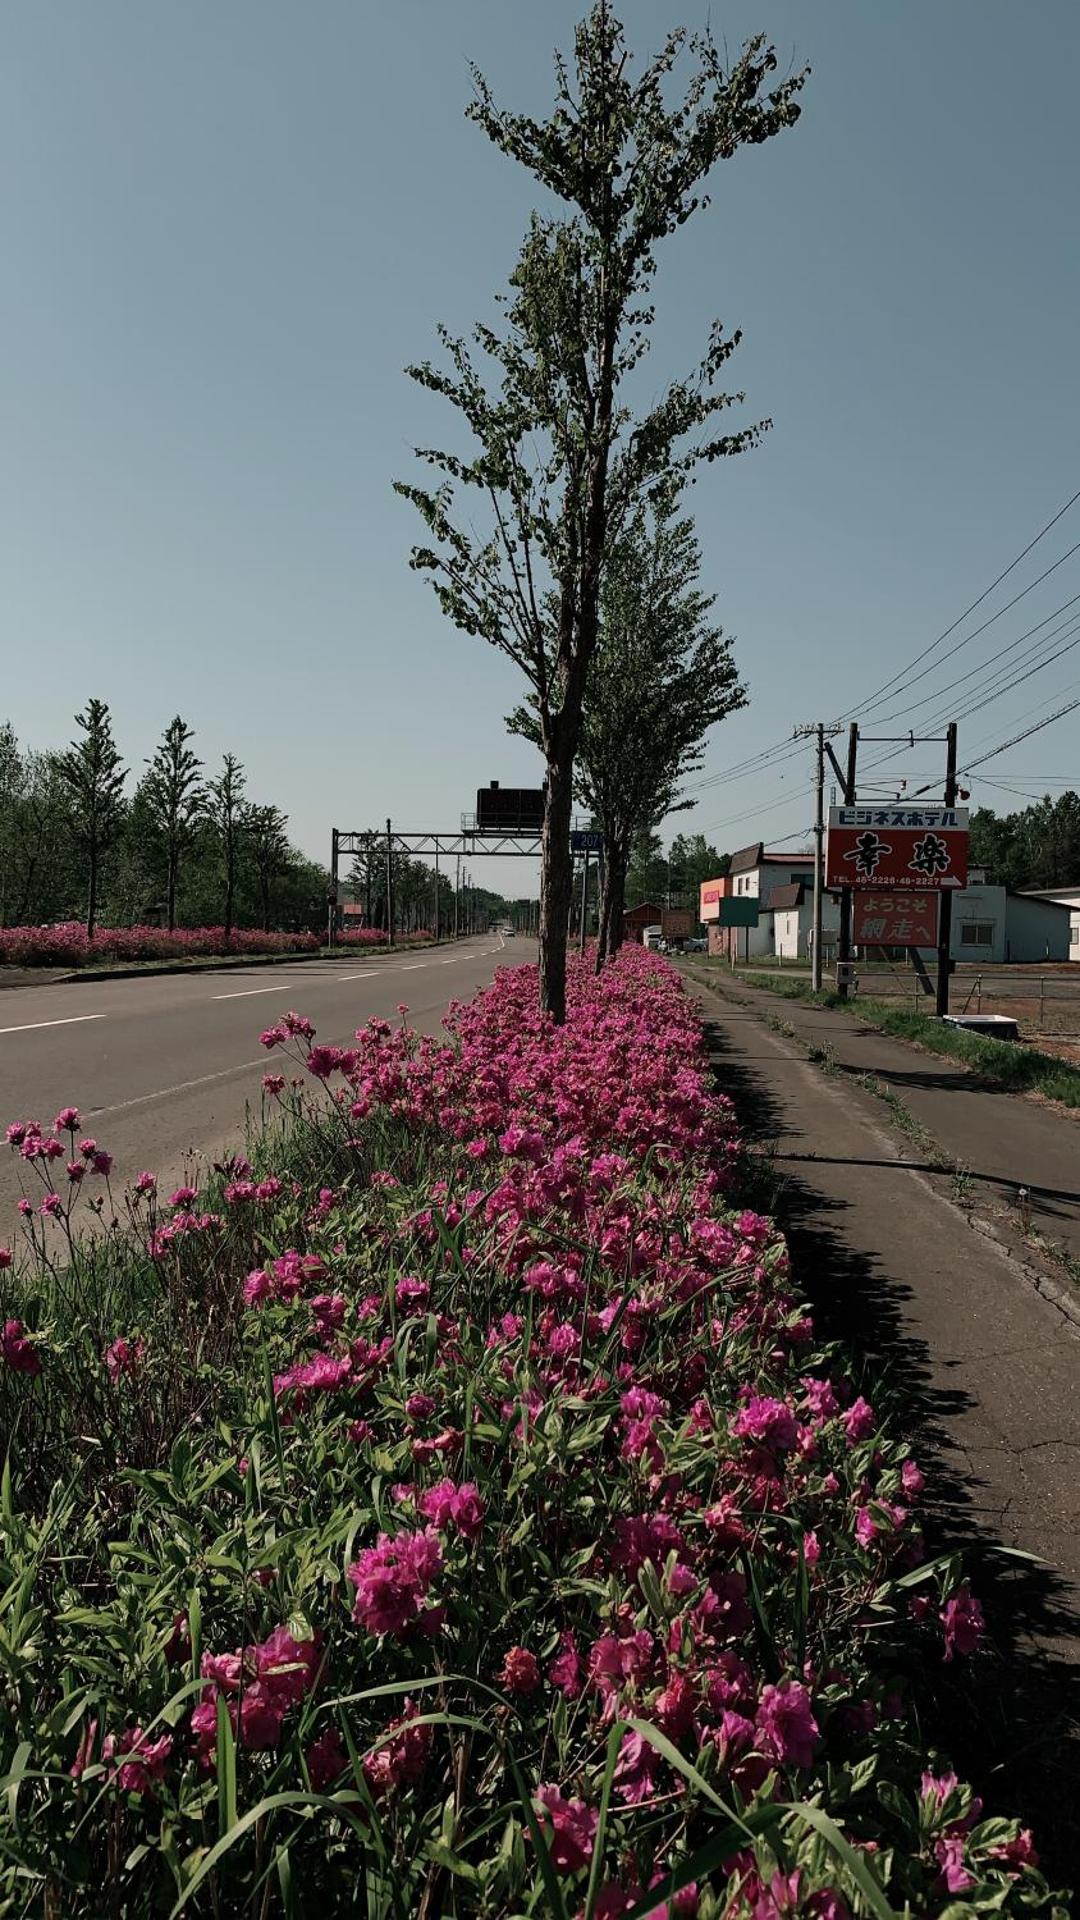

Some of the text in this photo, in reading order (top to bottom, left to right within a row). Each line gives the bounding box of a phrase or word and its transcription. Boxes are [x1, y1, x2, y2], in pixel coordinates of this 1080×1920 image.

[839, 810, 958, 826] ビジネスホテル
[863, 896, 928, 913] ようこそ
[859, 917, 931, 941] 網走へ
